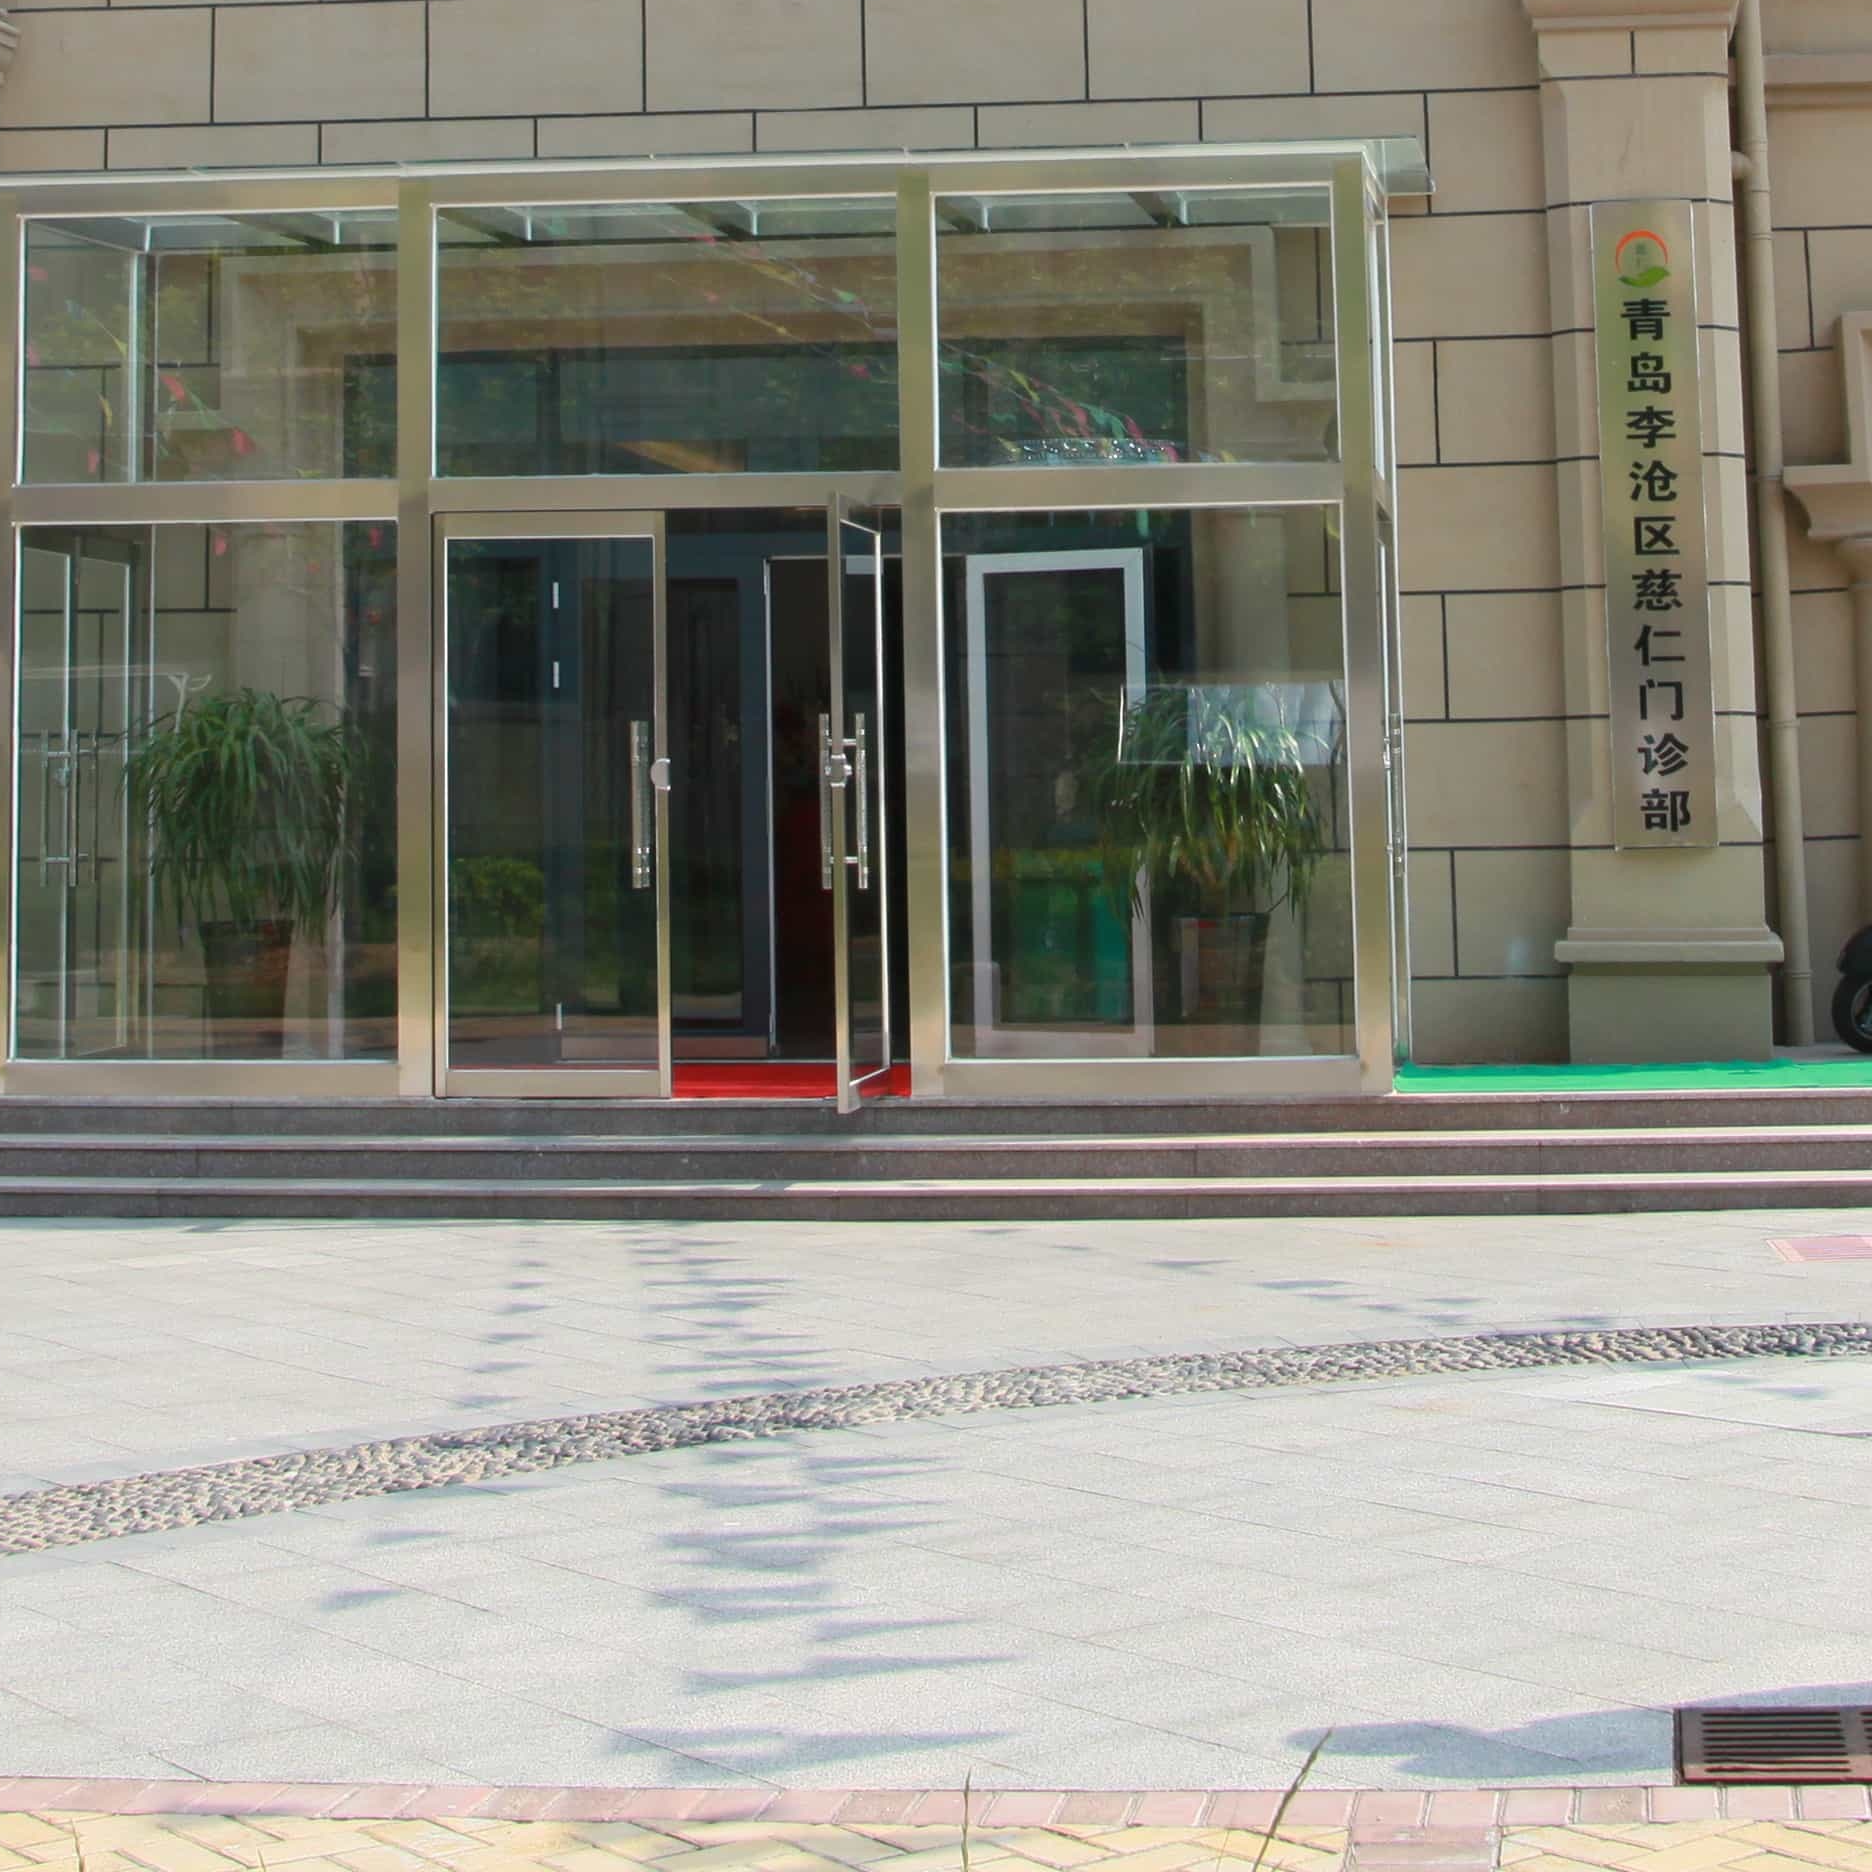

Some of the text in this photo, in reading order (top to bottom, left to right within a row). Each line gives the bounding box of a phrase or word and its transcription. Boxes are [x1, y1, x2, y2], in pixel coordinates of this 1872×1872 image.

[1620, 297, 1692, 834] 青岛李沧区慈仁门诊部
